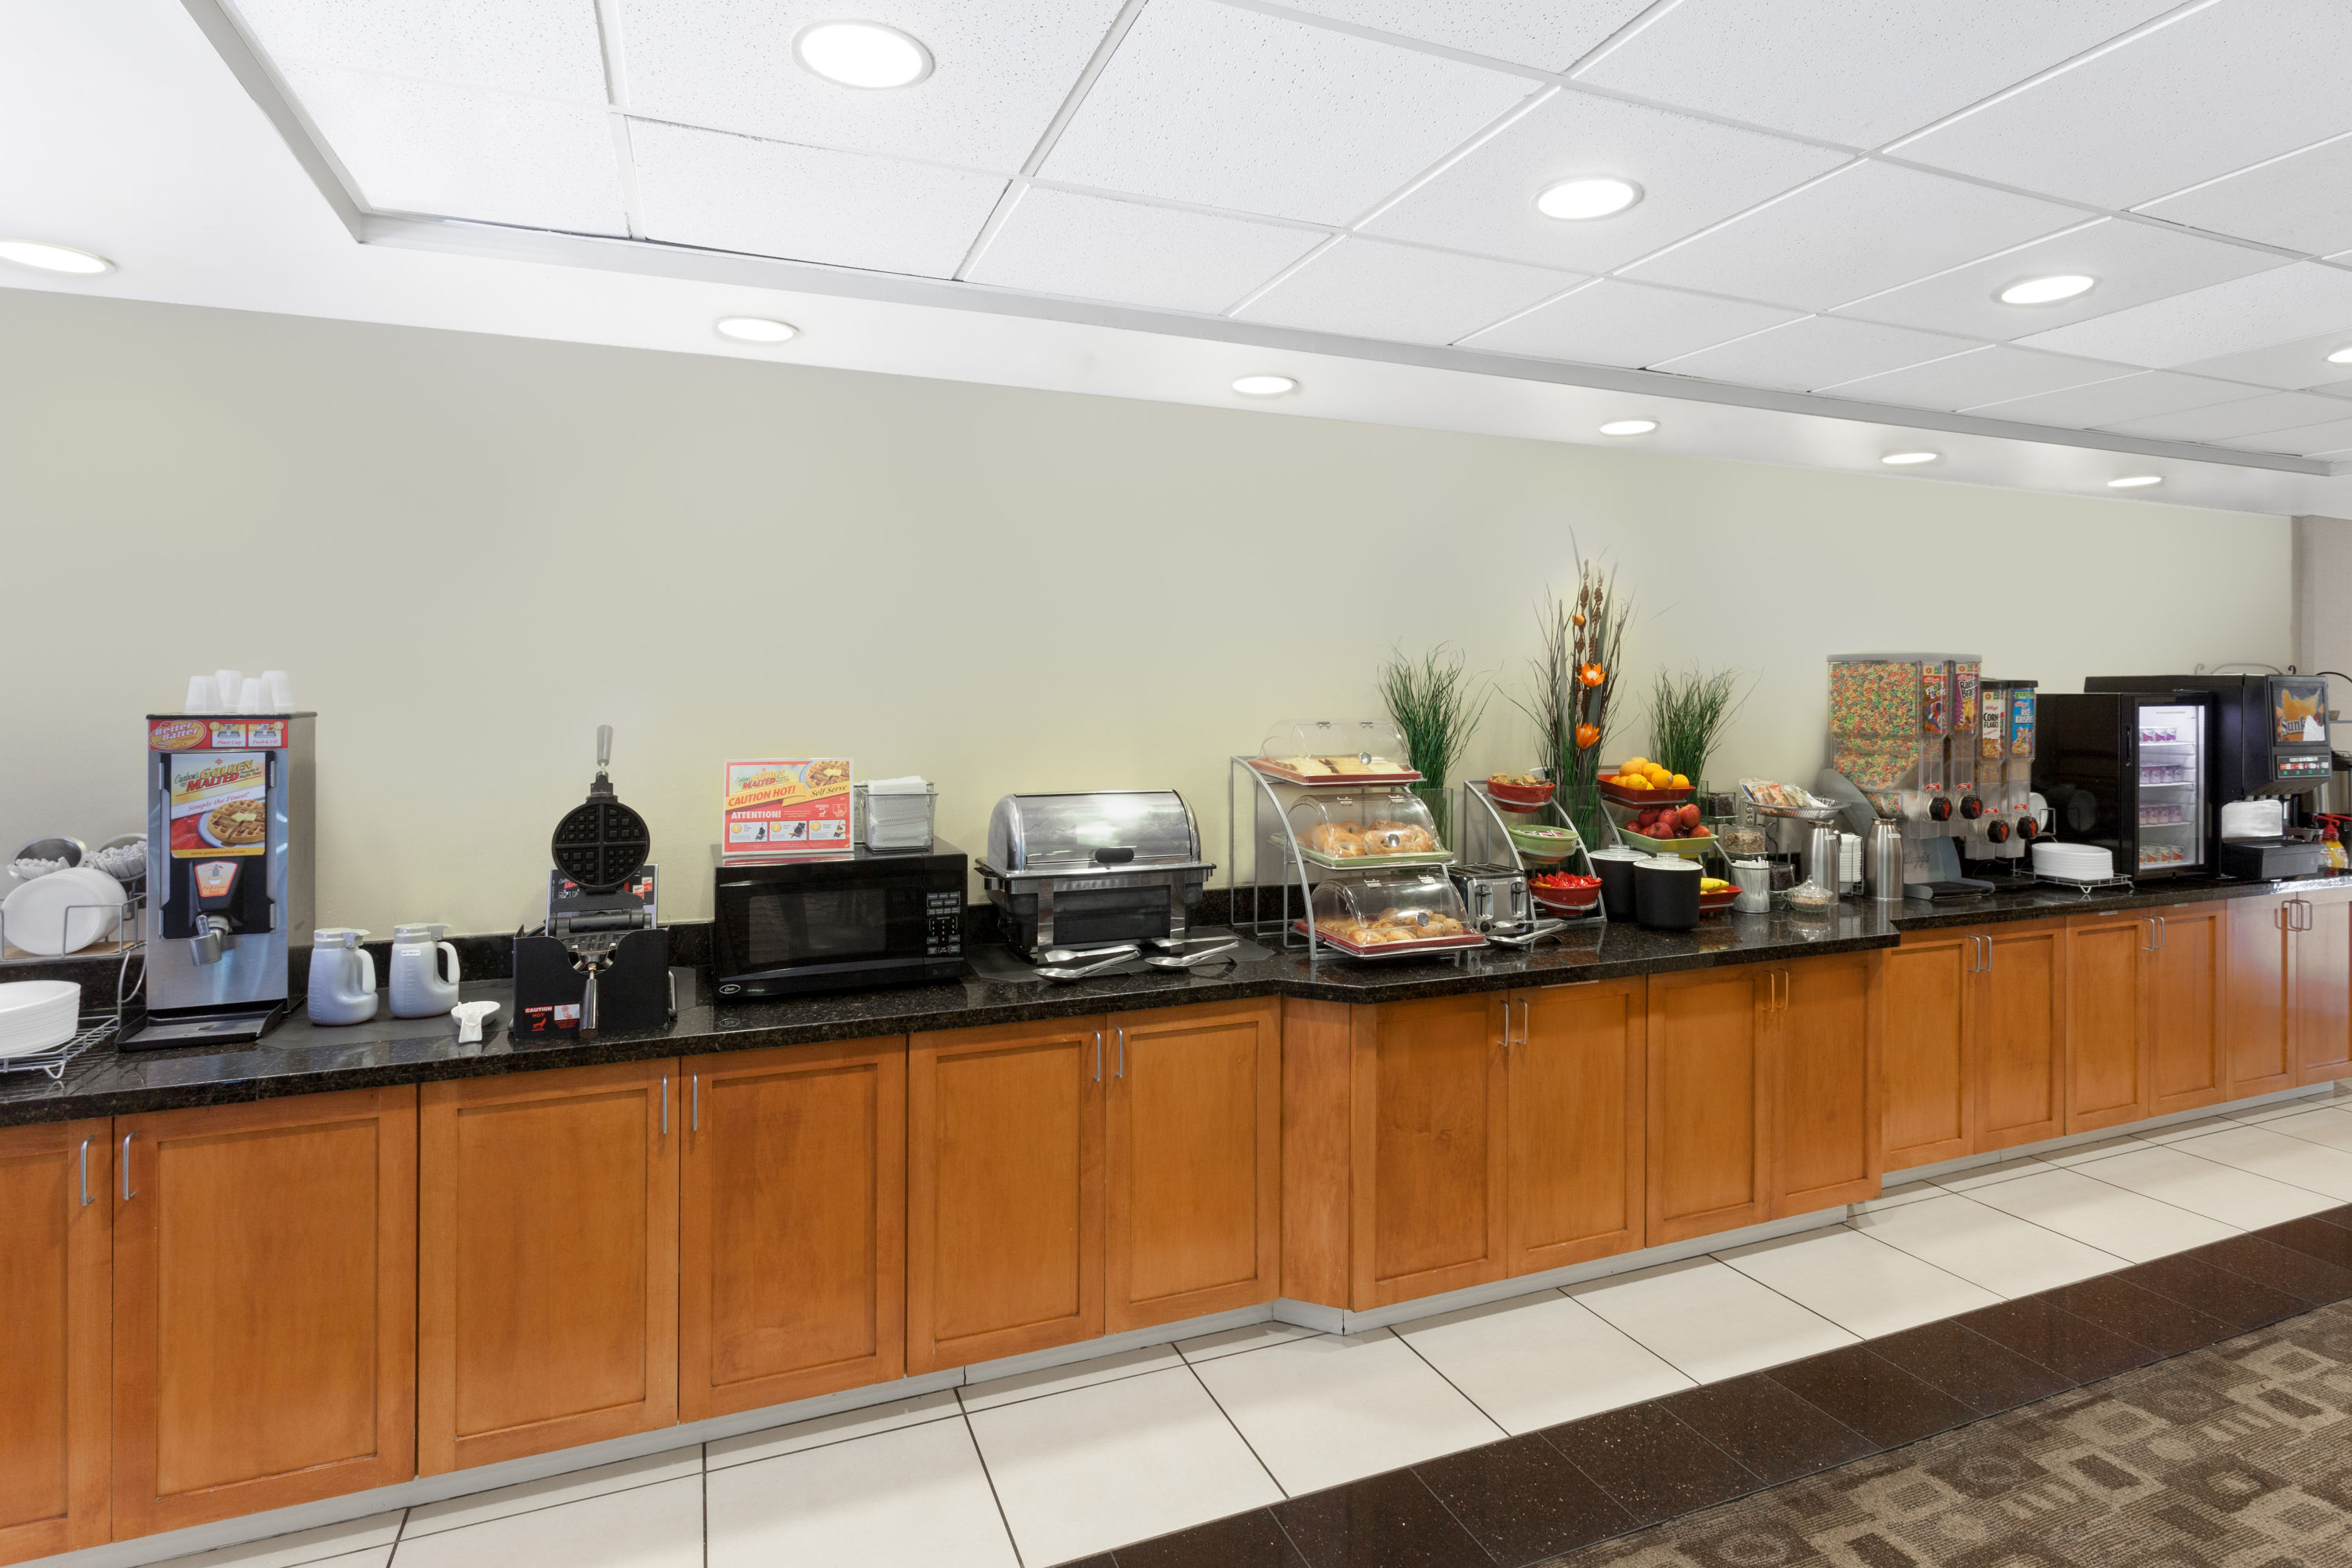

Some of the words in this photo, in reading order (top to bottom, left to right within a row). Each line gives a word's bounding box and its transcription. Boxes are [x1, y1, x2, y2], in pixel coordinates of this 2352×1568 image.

[1961, 687, 1976, 698] Bran
[1984, 713, 1998, 721] CORN
[154, 722, 193, 735] Better
[2281, 715, 2306, 735] Sunk
[162, 728, 199, 741] Batter
[200, 760, 253, 779] GOLDEN
[186, 771, 239, 792] MALTED
[742, 778, 777, 789] MALTED
[728, 790, 771, 807] CAUTION
[772, 785, 796, 798] HOT!
[811, 789, 826, 798] Self
[827, 785, 848, 793] Serve
[188, 801, 212, 811] Simply
[226, 791, 249, 802] Finest!
[731, 810, 782, 819] ATTENTION!
